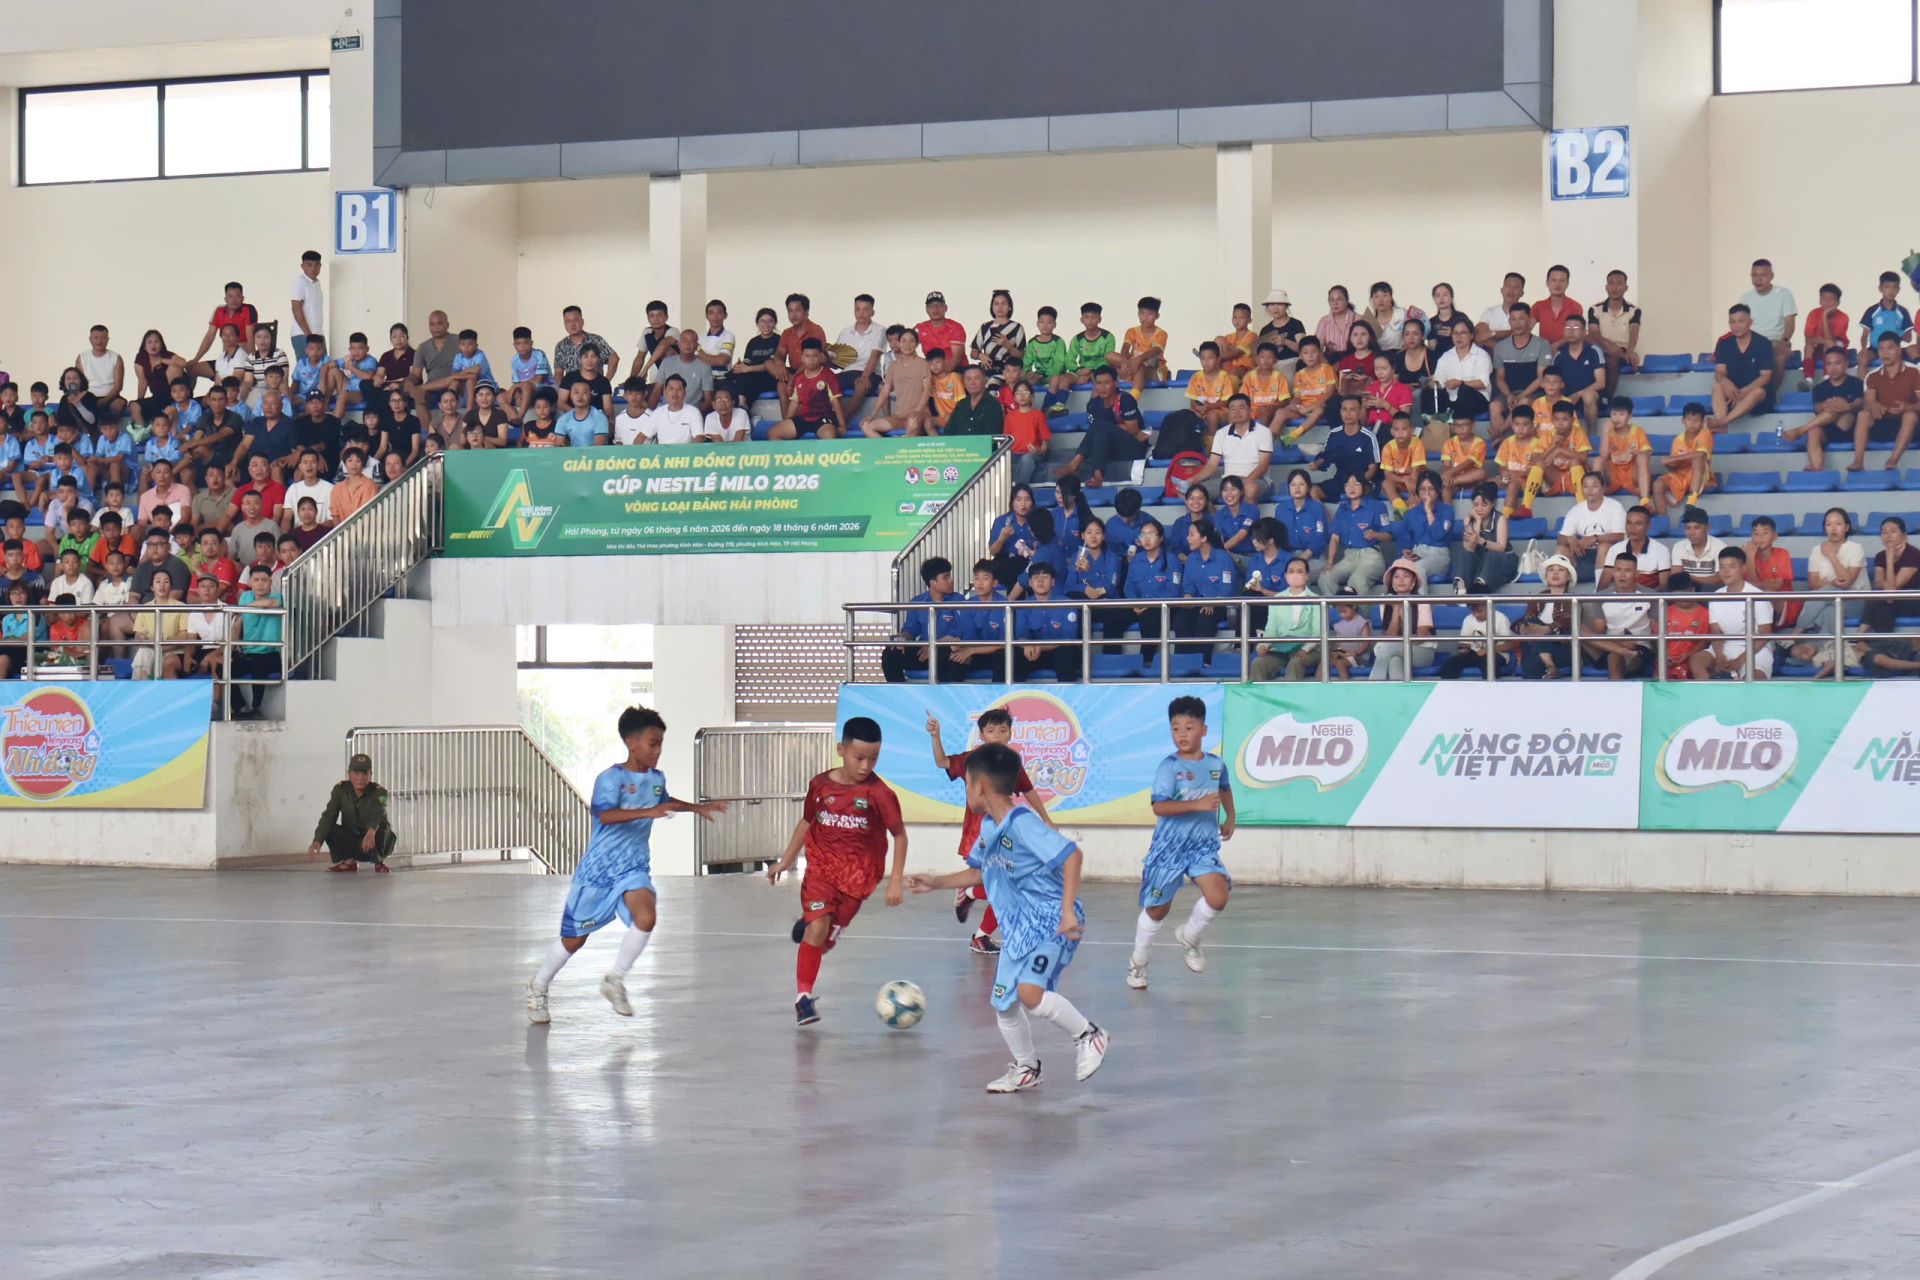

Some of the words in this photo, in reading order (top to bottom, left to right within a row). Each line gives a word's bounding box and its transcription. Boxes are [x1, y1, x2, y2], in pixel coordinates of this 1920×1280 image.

[1557, 130, 1625, 195] B2
[341, 194, 390, 250] B1
[563, 455, 593, 473] GIẢI
[595, 456, 636, 471] BÓNG
[639, 455, 661, 470] ĐÁ
[664, 456, 690, 469] NHI
[693, 451, 735, 468] ĐỒNG
[738, 453, 770, 470] (U11)
[774, 450, 815, 464] TOÀN
[818, 448, 861, 465] QUỐC
[602, 475, 642, 494] CÚP
[646, 472, 717, 493] NESTLÉ
[719, 473, 769, 492] MILO
[772, 472, 820, 491] 2026
[625, 500, 659, 512] VÒNG
[661, 500, 689, 514] LOẠI
[692, 497, 727, 511] BẢNG
[730, 496, 751, 509] HẢI
[754, 496, 799, 509] PHÒNG
[710, 524, 731, 533] 2026
[810, 522, 817, 530] 6
[839, 521, 861, 531] 2026
[1256, 735, 1354, 767] MILO
[1419, 728, 1522, 765] NĂNG
[1677, 738, 1783, 771] MILO
[1510, 755, 1584, 776] NAM
[1031, 955, 1049, 975] 9
